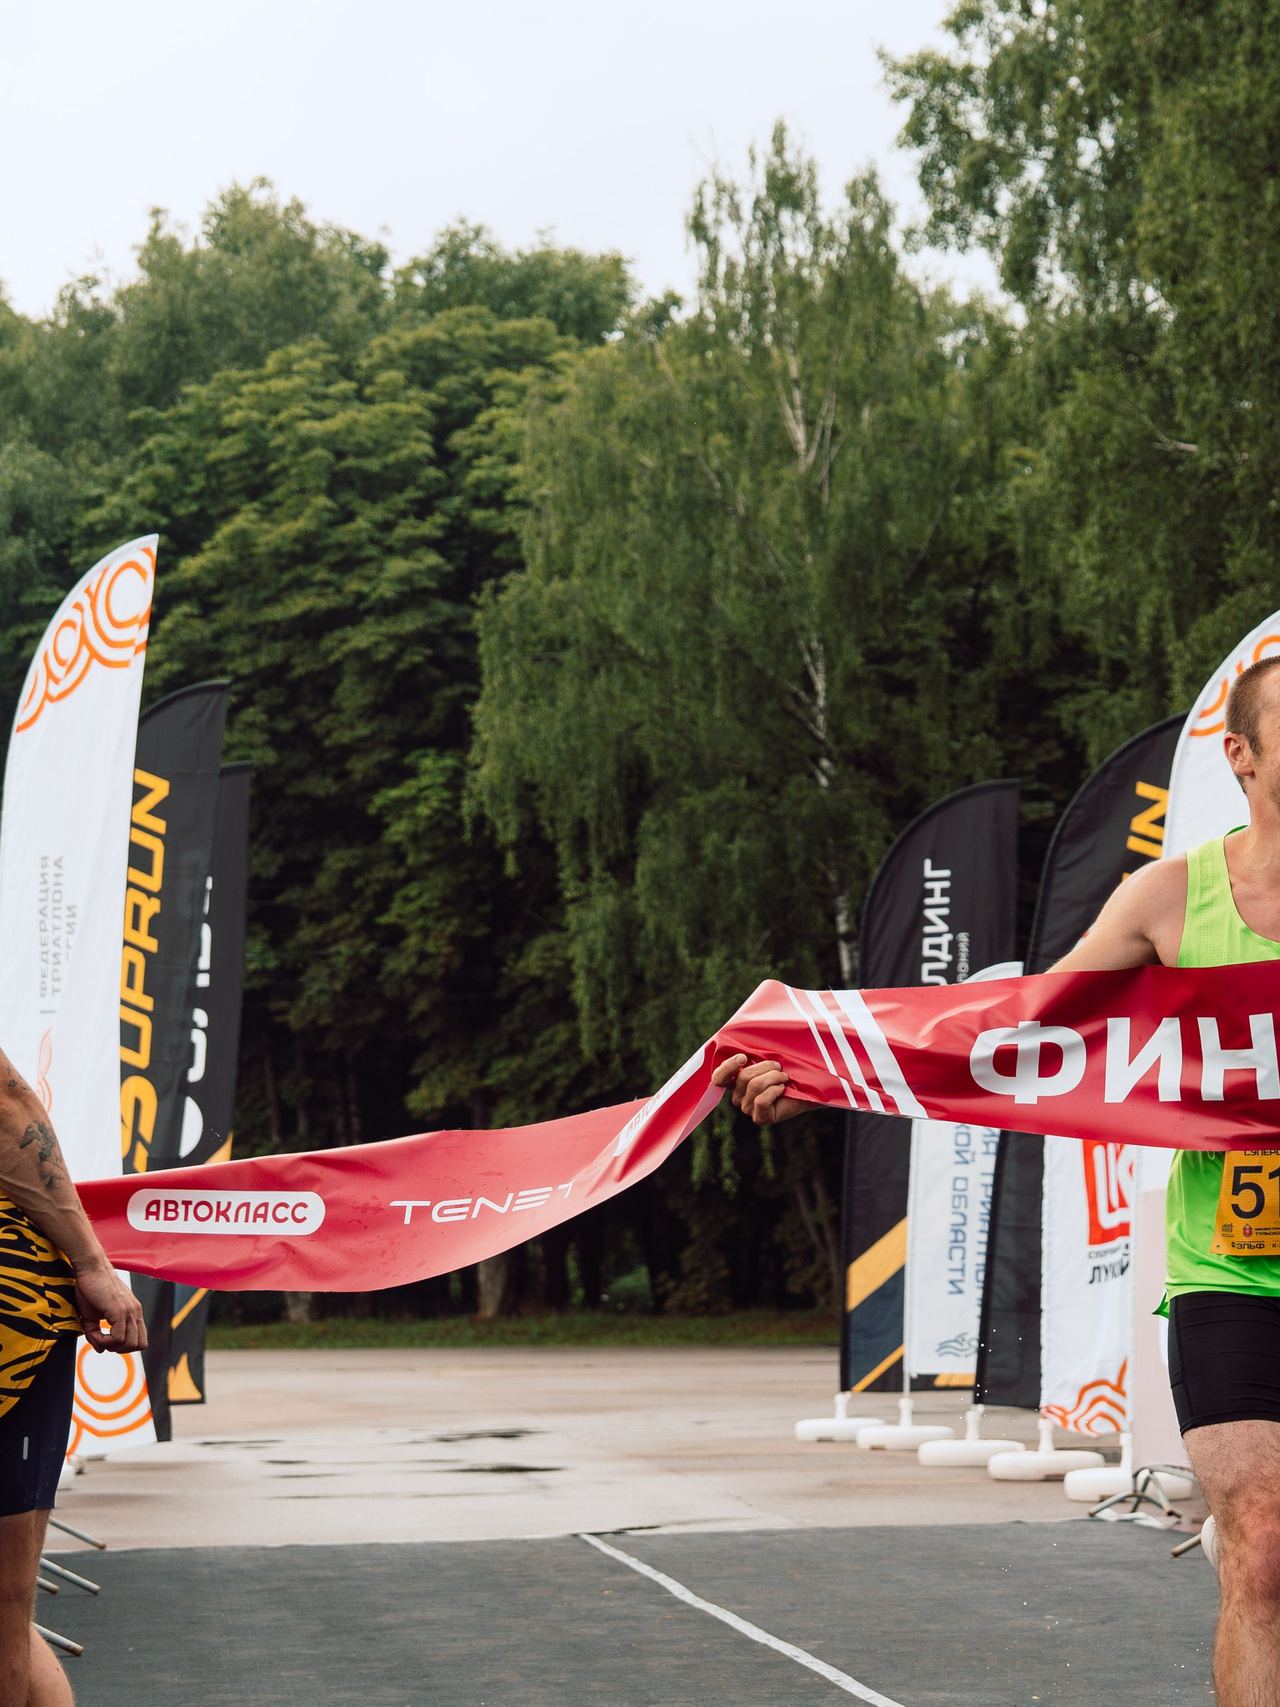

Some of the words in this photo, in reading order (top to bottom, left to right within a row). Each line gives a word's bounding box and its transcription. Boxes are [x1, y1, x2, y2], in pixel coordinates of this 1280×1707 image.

[38, 855, 50, 998] ФЕДЕРАЦИЯ
[51, 855, 64, 998] ТРИАТЛОНА
[144, 1198, 309, 1224] АВТОКЛАСС
[389, 1173, 586, 1225] TENET
[947, 1177, 969, 1296] ОБЛАСТИ
